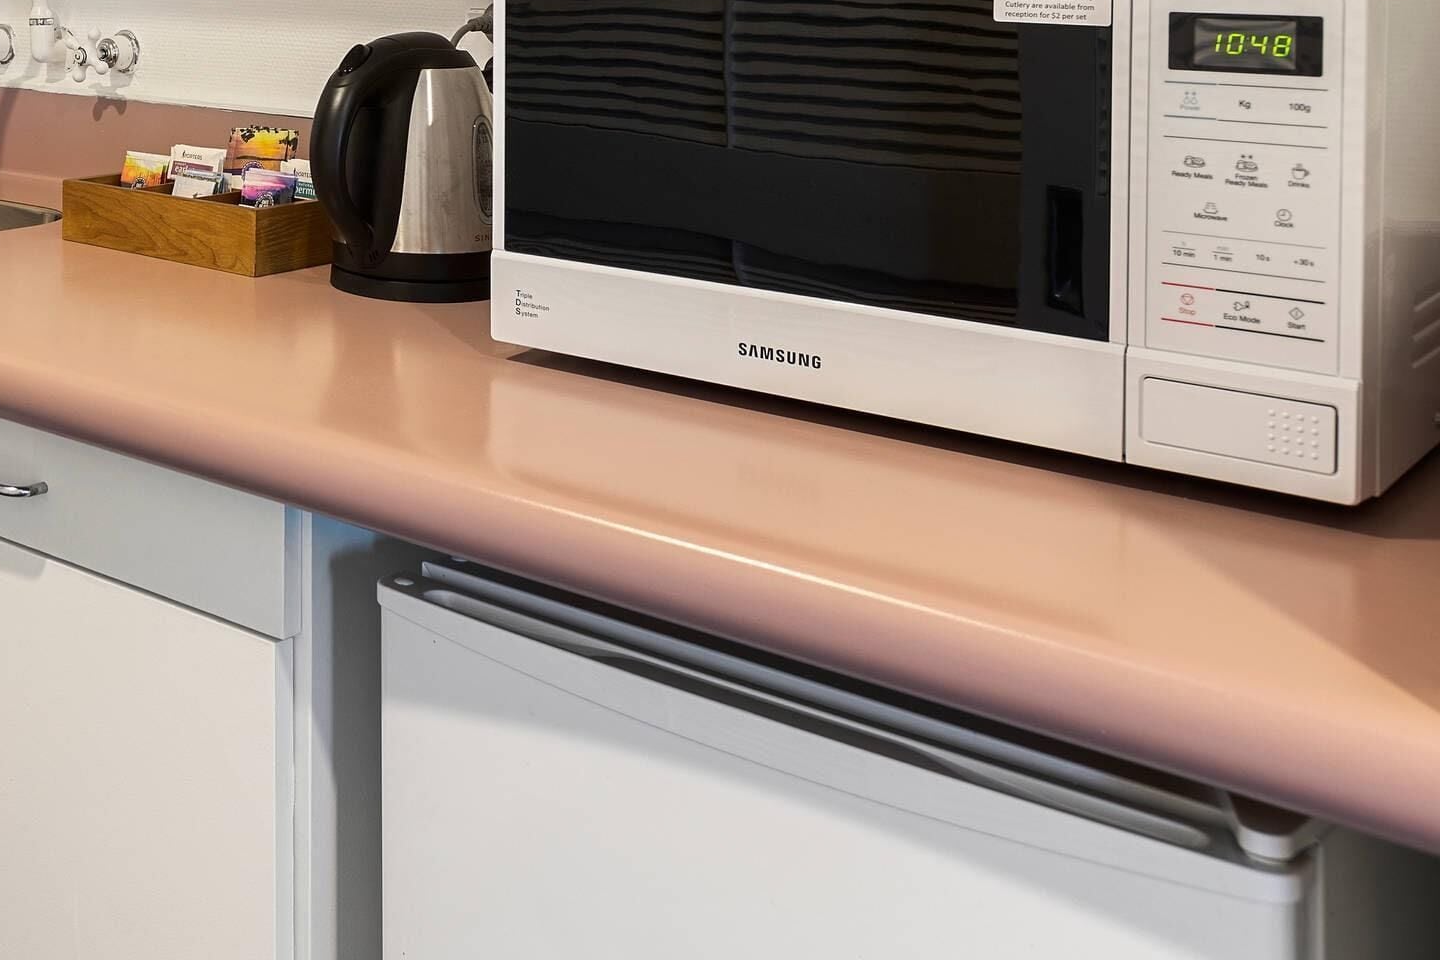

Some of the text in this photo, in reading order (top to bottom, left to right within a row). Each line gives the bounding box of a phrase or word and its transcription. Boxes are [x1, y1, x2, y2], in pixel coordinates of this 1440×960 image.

[1005, 0, 1030, 9] Cutlery
[1044, 2, 1076, 10] available
[1005, 11, 1038, 19] reception
[1062, 13, 1074, 21] per
[1238, 100, 1252, 110] Kg
[1289, 103, 1311, 113] 100g
[1171, 170, 1213, 180] Ready Meals
[1235, 173, 1258, 181] Frozen
[1225, 178, 1246, 187] Ready
[1193, 212, 1228, 222] Microwave
[1274, 220, 1294, 228] Clock
[1172, 249, 1196, 258] 10 min
[515, 289, 533, 299] Triple
[515, 298, 550, 312] Distribution
[515, 307, 539, 318] System
[1223, 313, 1261, 324] Eco Mode
[1287, 321, 1306, 330] Start
[738, 342, 822, 369] SAMSUNG
